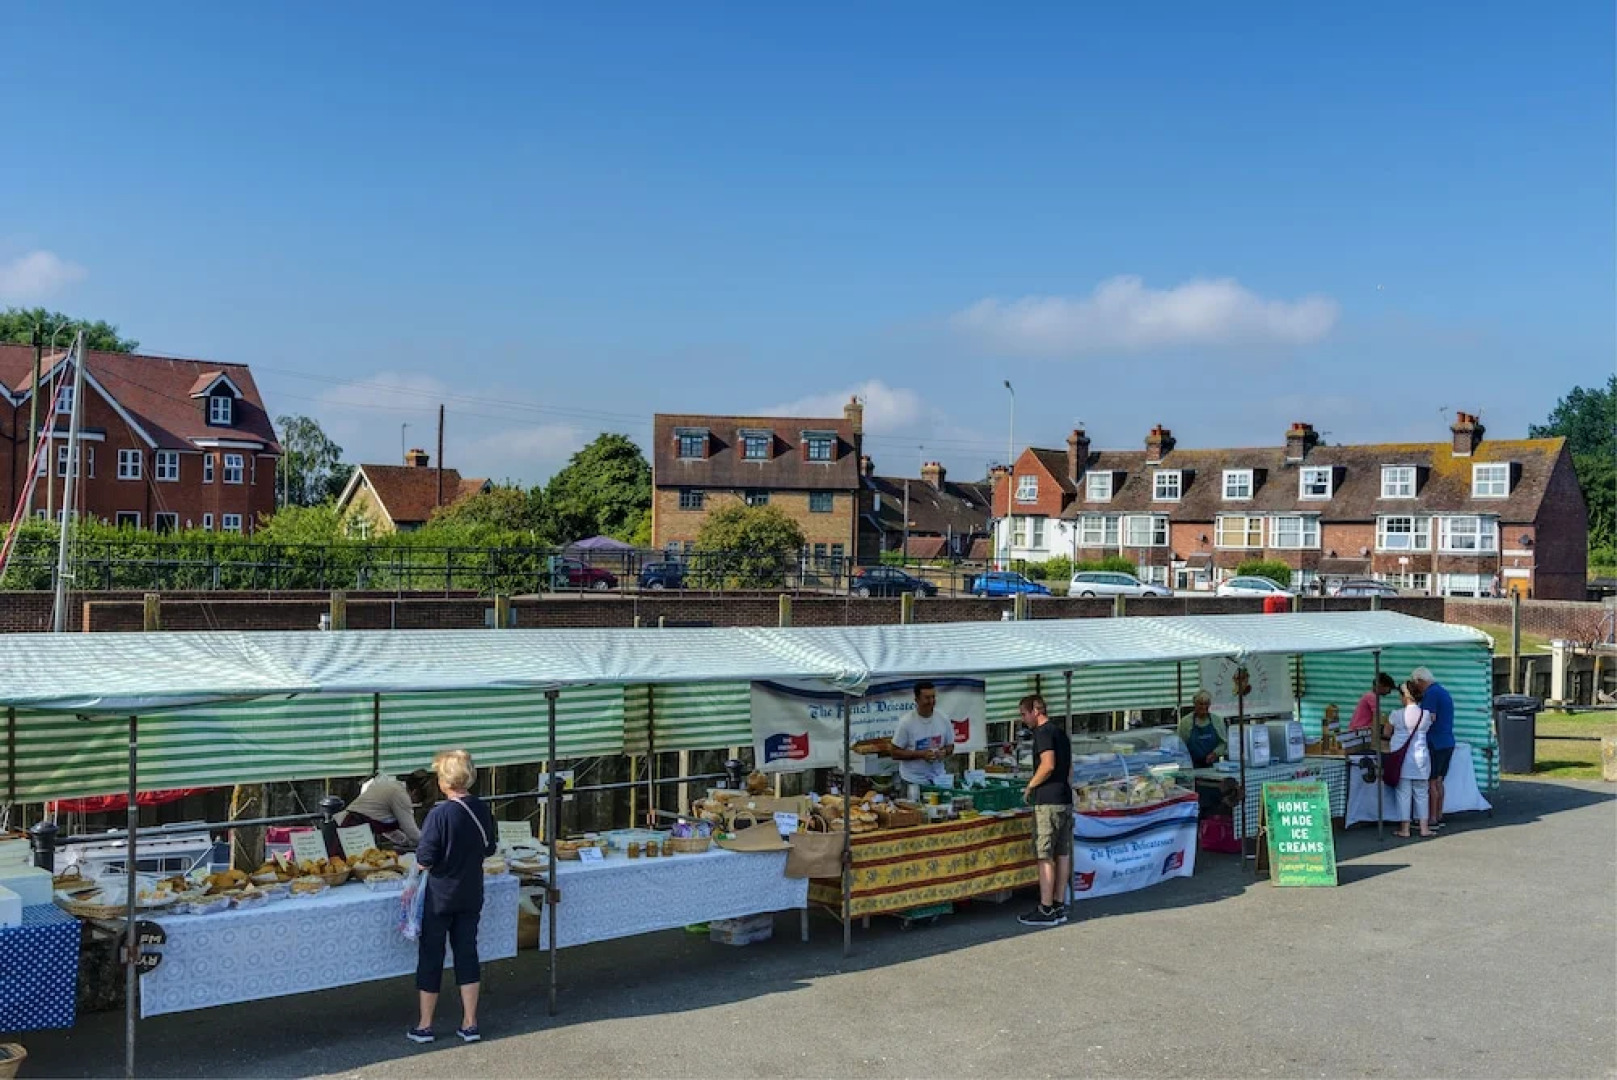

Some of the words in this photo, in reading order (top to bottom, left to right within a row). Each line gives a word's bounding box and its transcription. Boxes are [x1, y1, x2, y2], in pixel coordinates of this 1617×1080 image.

[808, 702, 832, 719] The
[1277, 801, 1317, 812] HOME-
[1281, 814, 1313, 827] MADE
[1291, 827, 1309, 840] ICE
[1278, 841, 1325, 853] CREAMS
